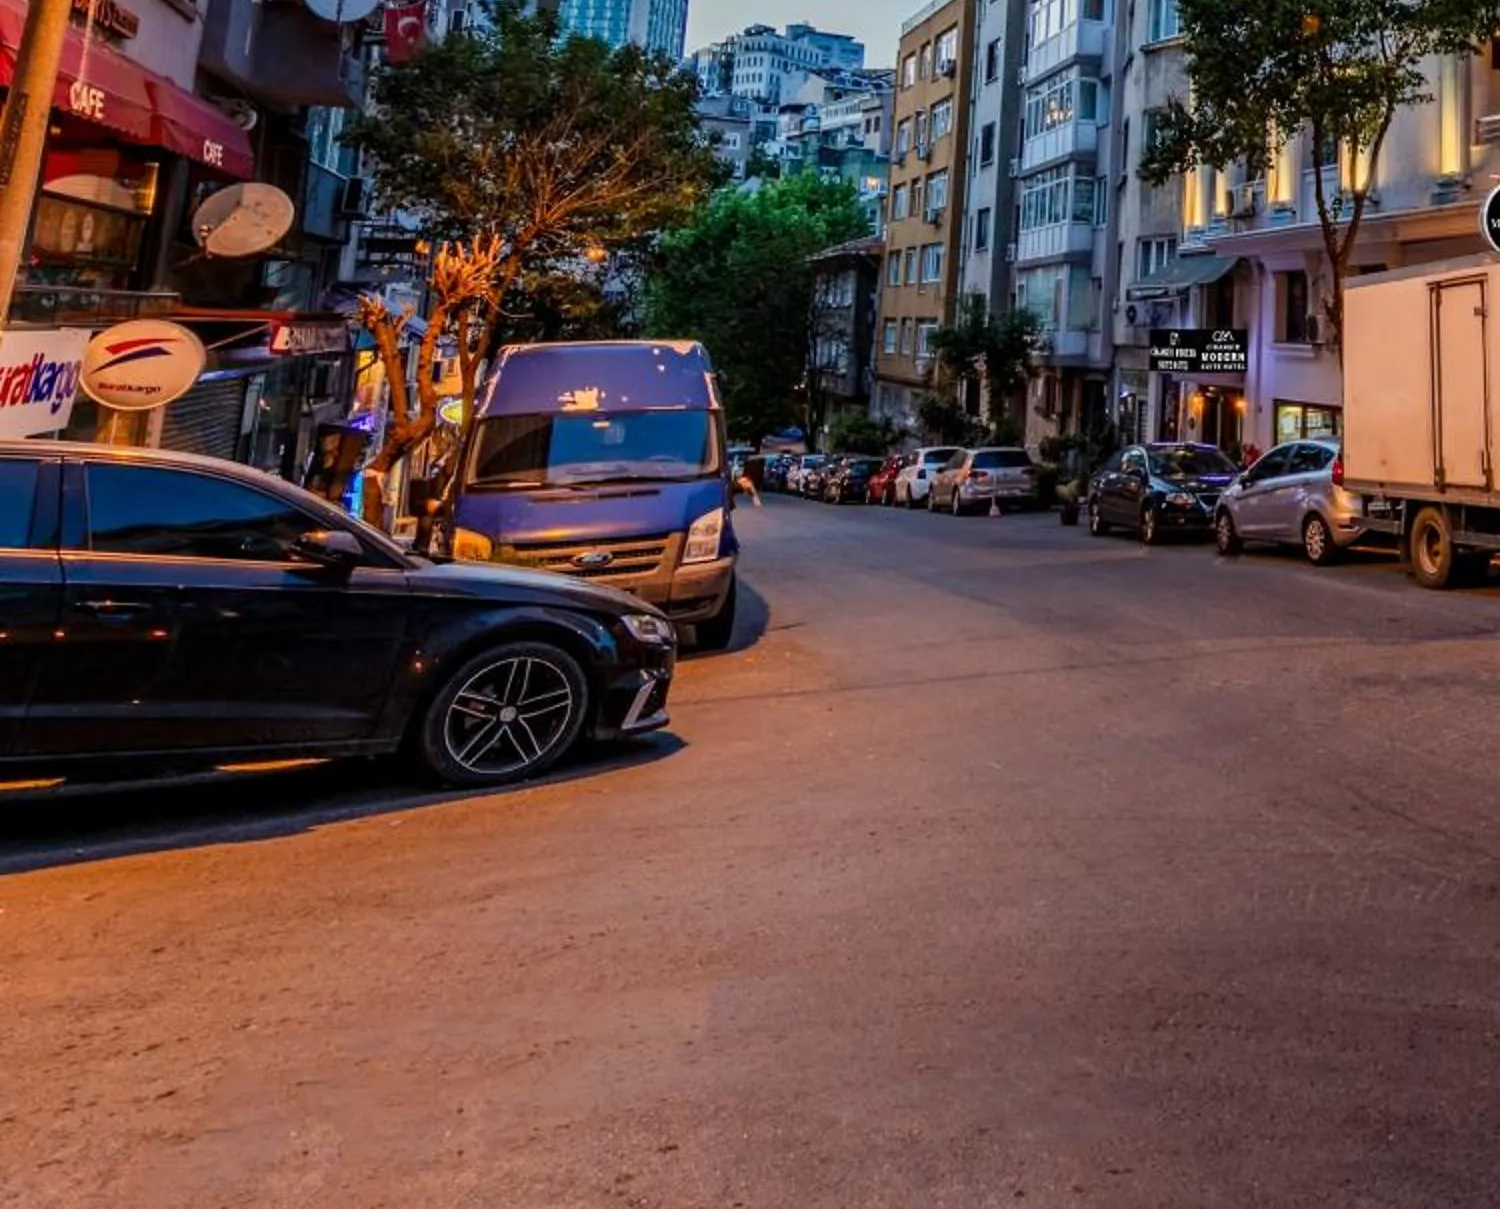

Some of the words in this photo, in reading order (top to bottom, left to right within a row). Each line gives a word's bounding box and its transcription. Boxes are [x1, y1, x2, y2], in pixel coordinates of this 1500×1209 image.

[69, 81, 105, 119] CAFE
[203, 140, 224, 166] CAFE
[1201, 352, 1245, 362] MODERN
[0, 353, 82, 415] ratkargo
